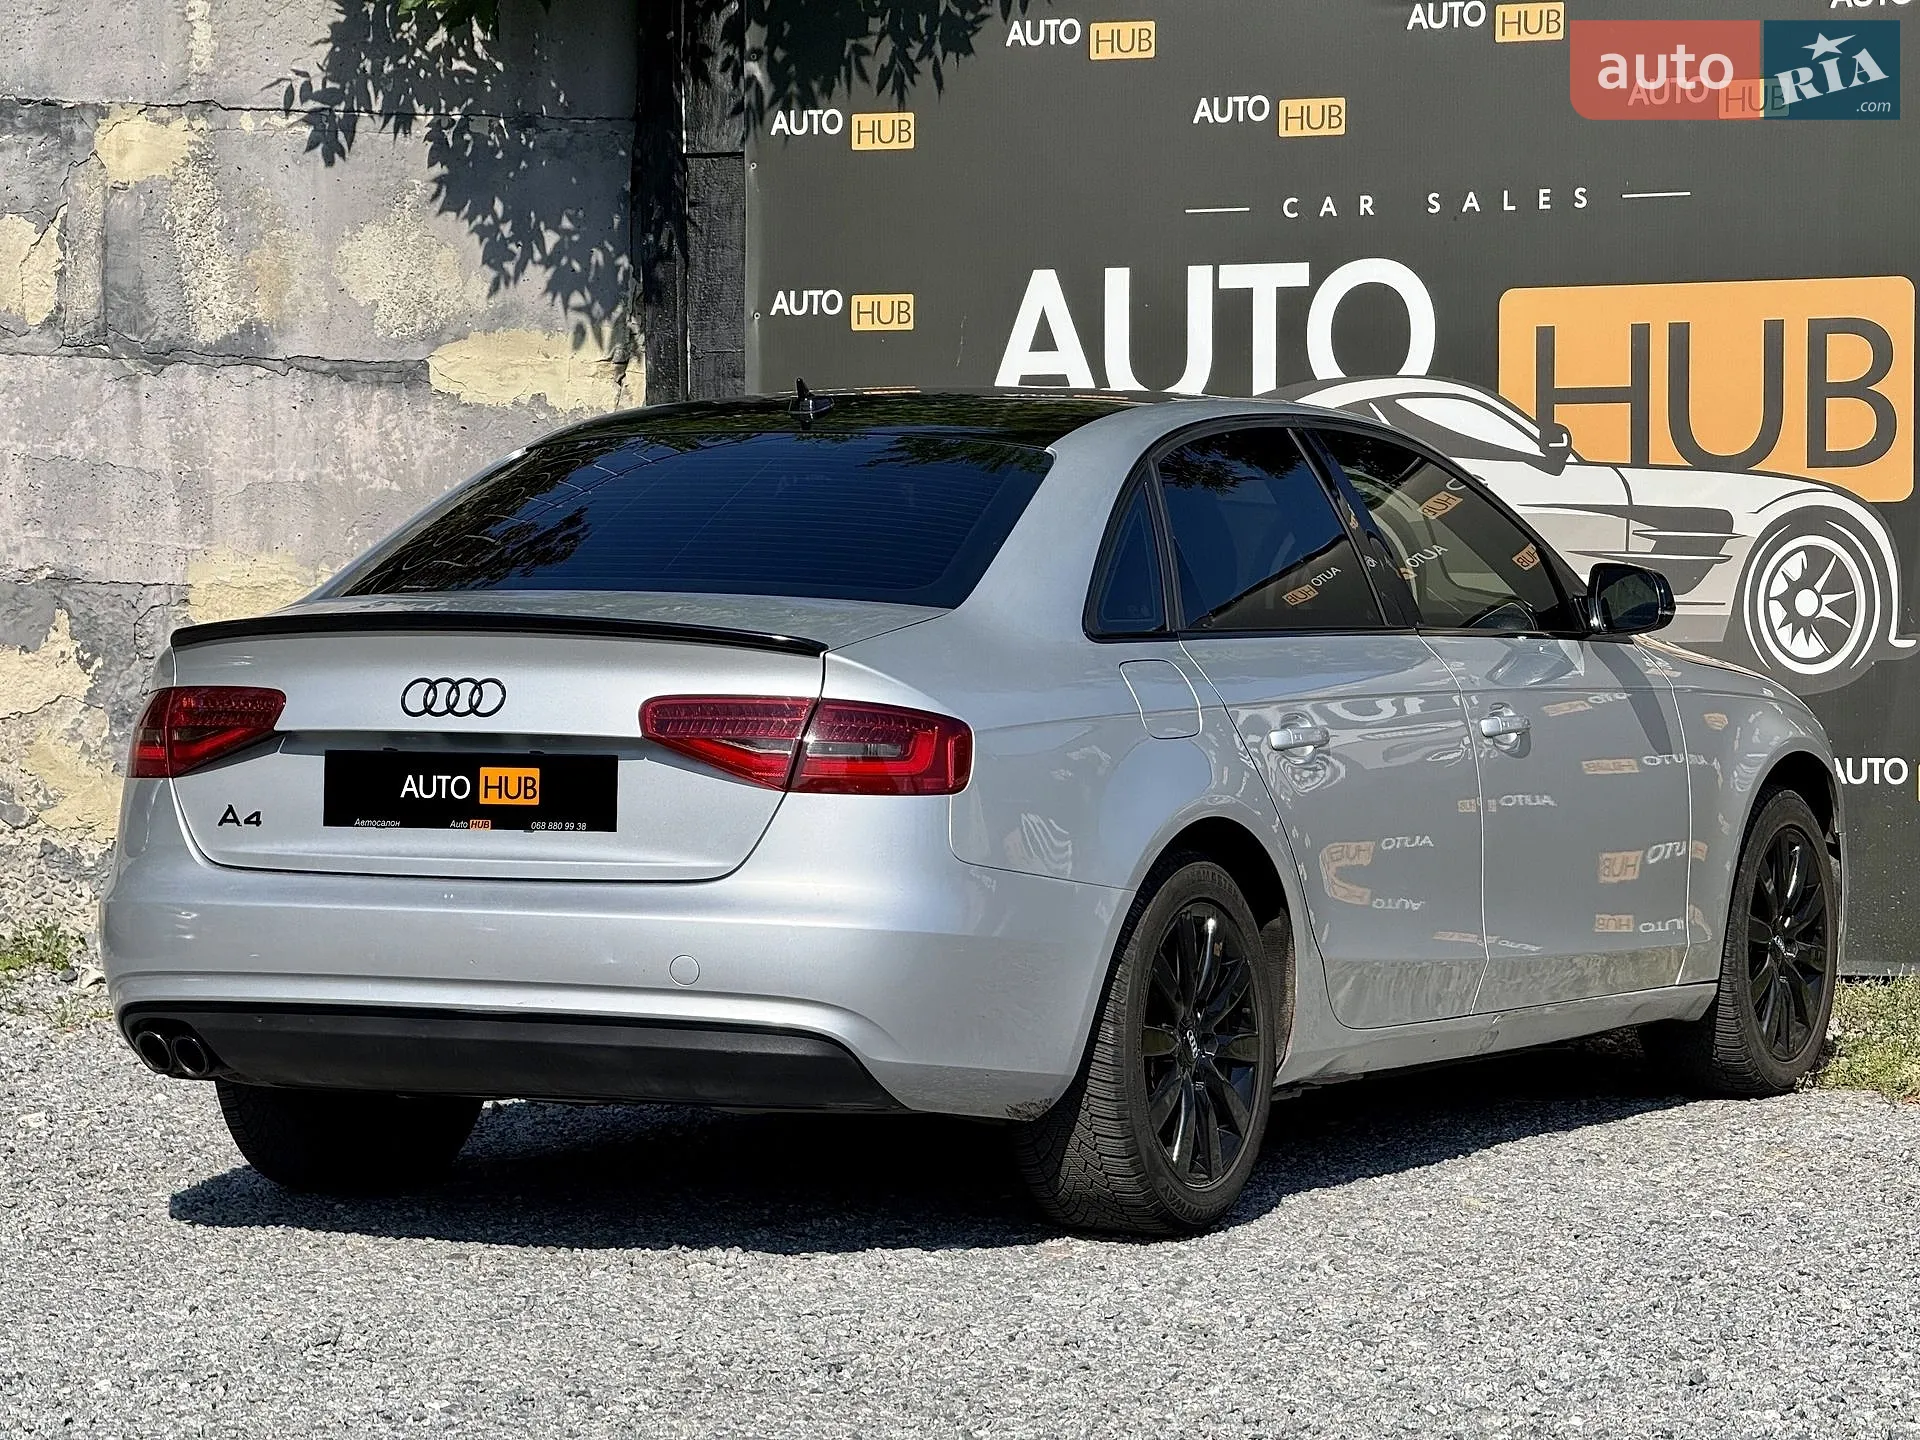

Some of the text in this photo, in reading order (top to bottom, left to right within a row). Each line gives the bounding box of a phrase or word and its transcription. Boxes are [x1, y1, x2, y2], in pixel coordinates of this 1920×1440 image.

[1407, 0, 1561, 36] AUTO HUB
[1006, 18, 1152, 54] AUTO HUB
[1628, 76, 1709, 106] AUTO
[770, 109, 912, 145] AUTO HUB
[1193, 95, 1343, 131] AUTO HUB
[1282, 187, 1588, 219] CAR SALES
[770, 289, 911, 325] AUTO HUB
[994, 257, 1898, 470] AUTO HUB
[400, 775, 538, 800] AUTO HUB
[217, 803, 263, 828] A4
[354, 818, 400, 828] Автосалон
[450, 819, 490, 830] Auto HUB
[531, 821, 587, 831] 068 880 99 38
